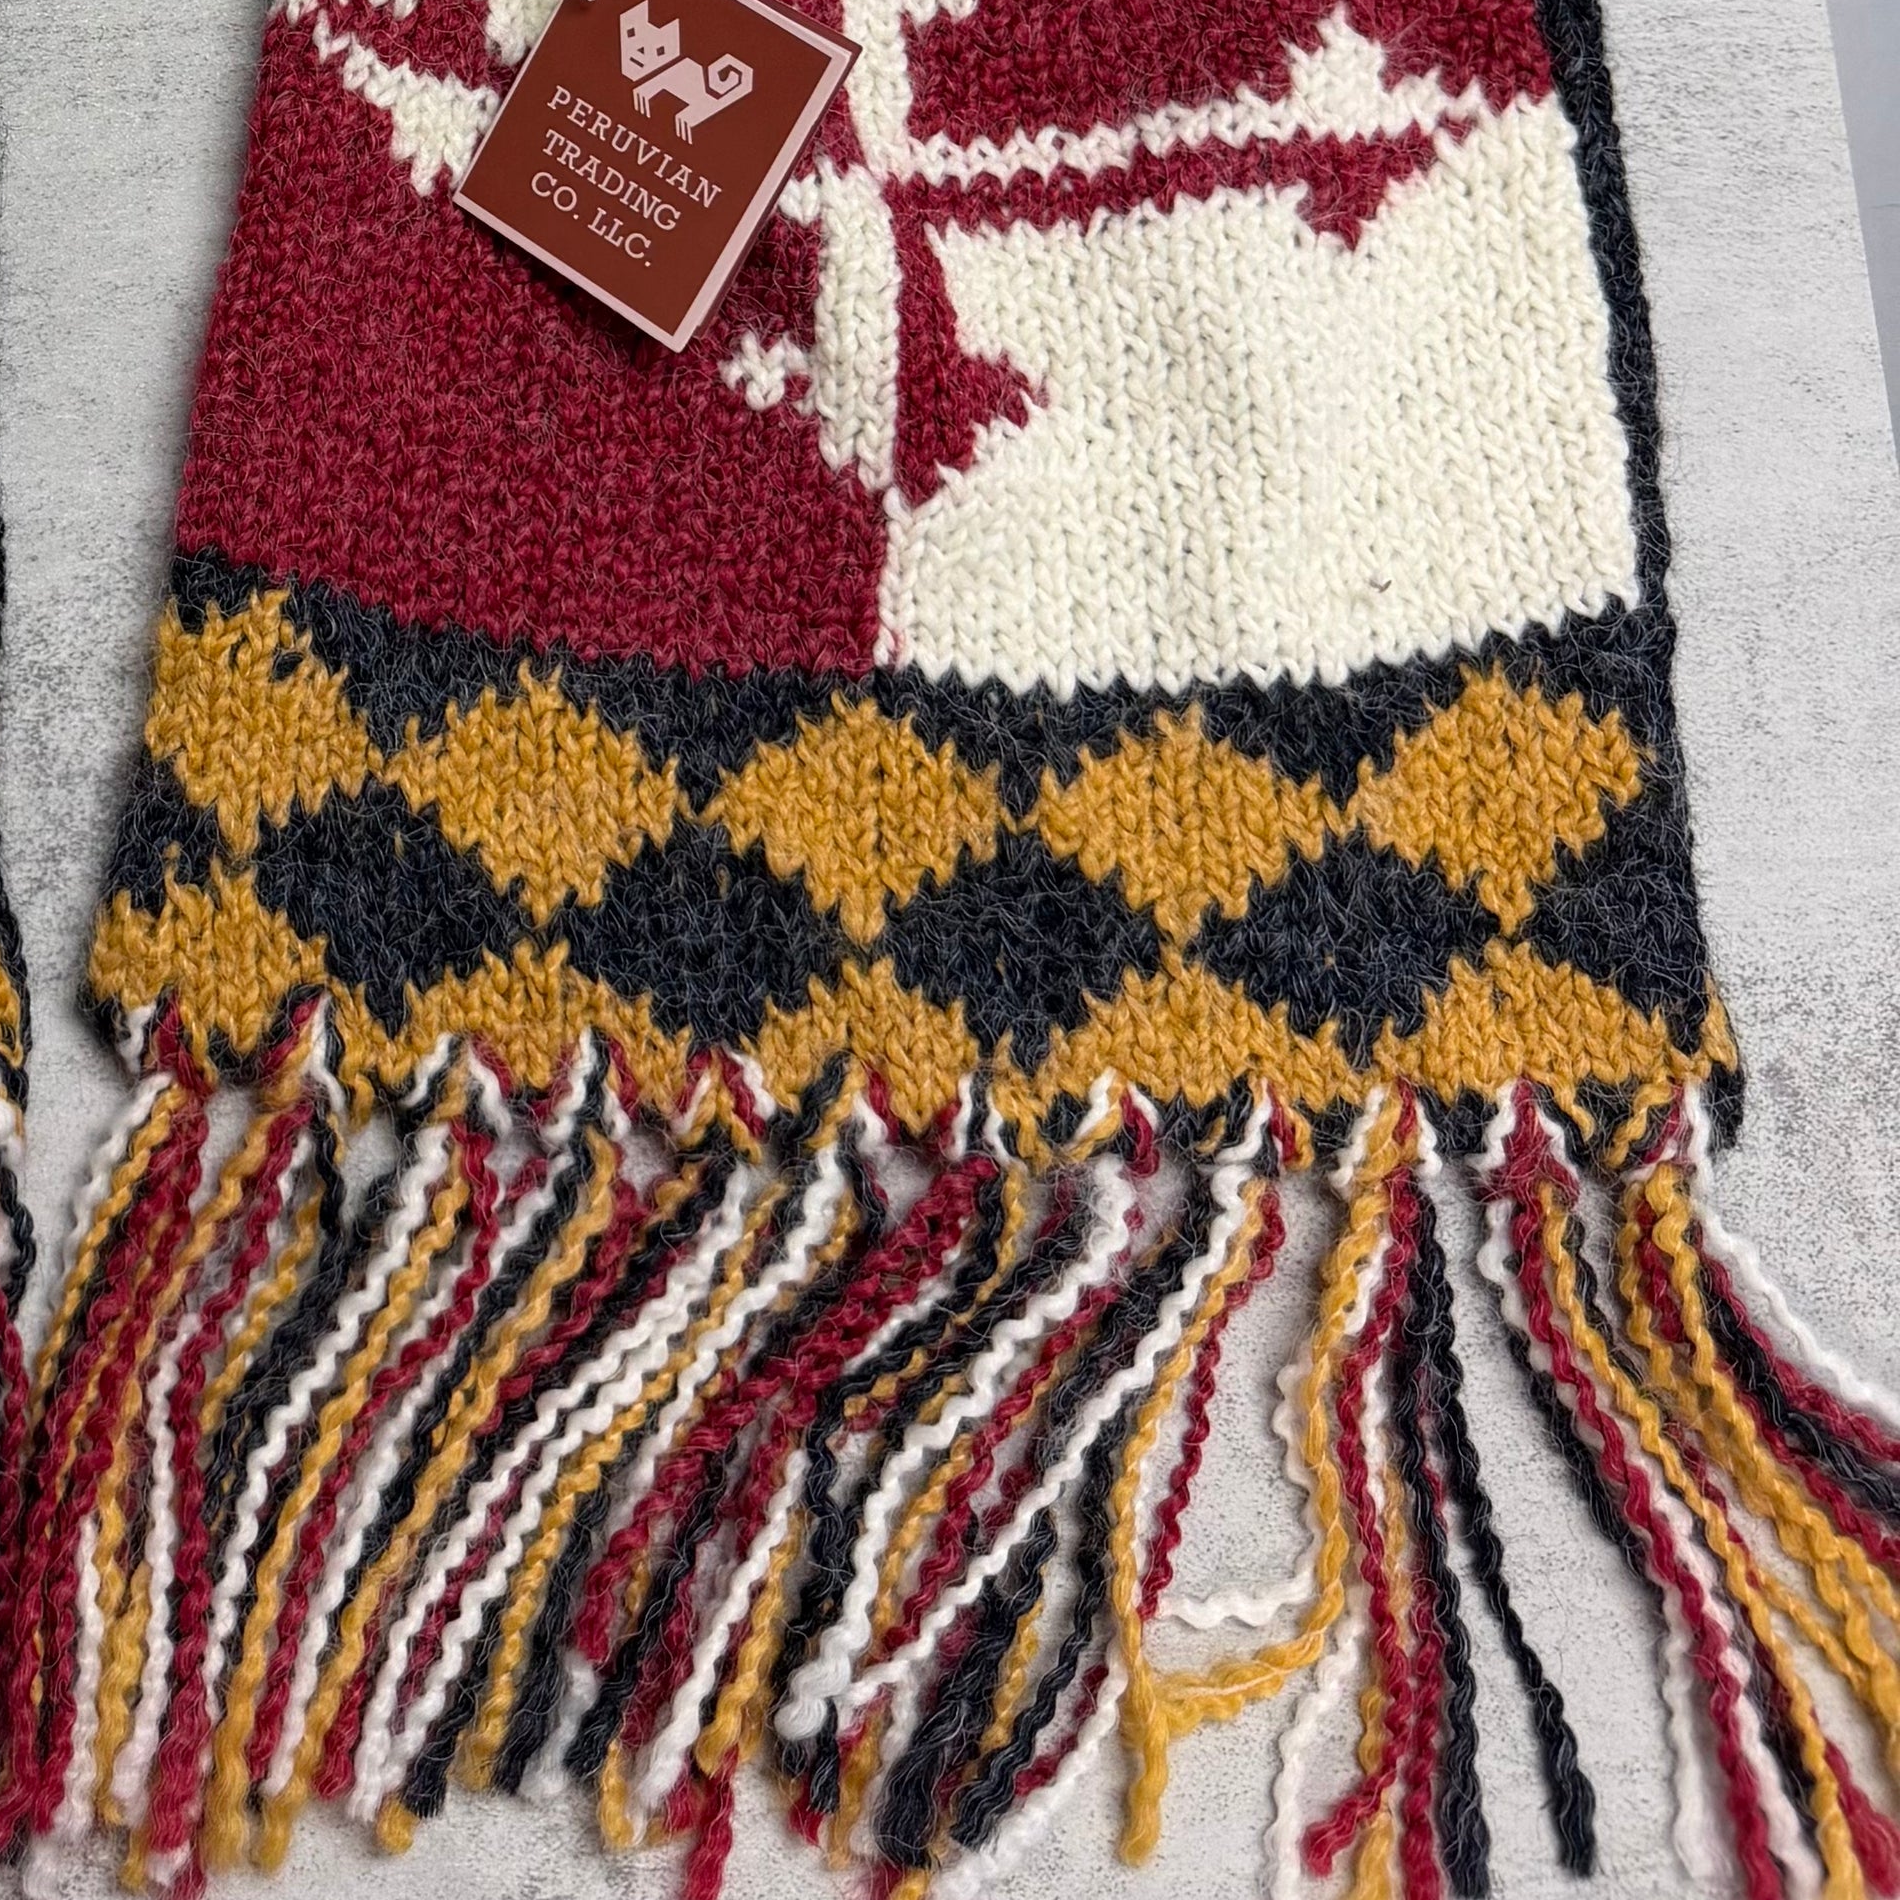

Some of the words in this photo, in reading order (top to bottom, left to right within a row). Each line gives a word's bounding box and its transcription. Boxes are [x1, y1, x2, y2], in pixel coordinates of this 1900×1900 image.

[542, 129, 681, 231] TRADING
[547, 85, 722, 209] PERUVIAN
[531, 171, 579, 219] CO.
[587, 207, 651, 267] LLC.
